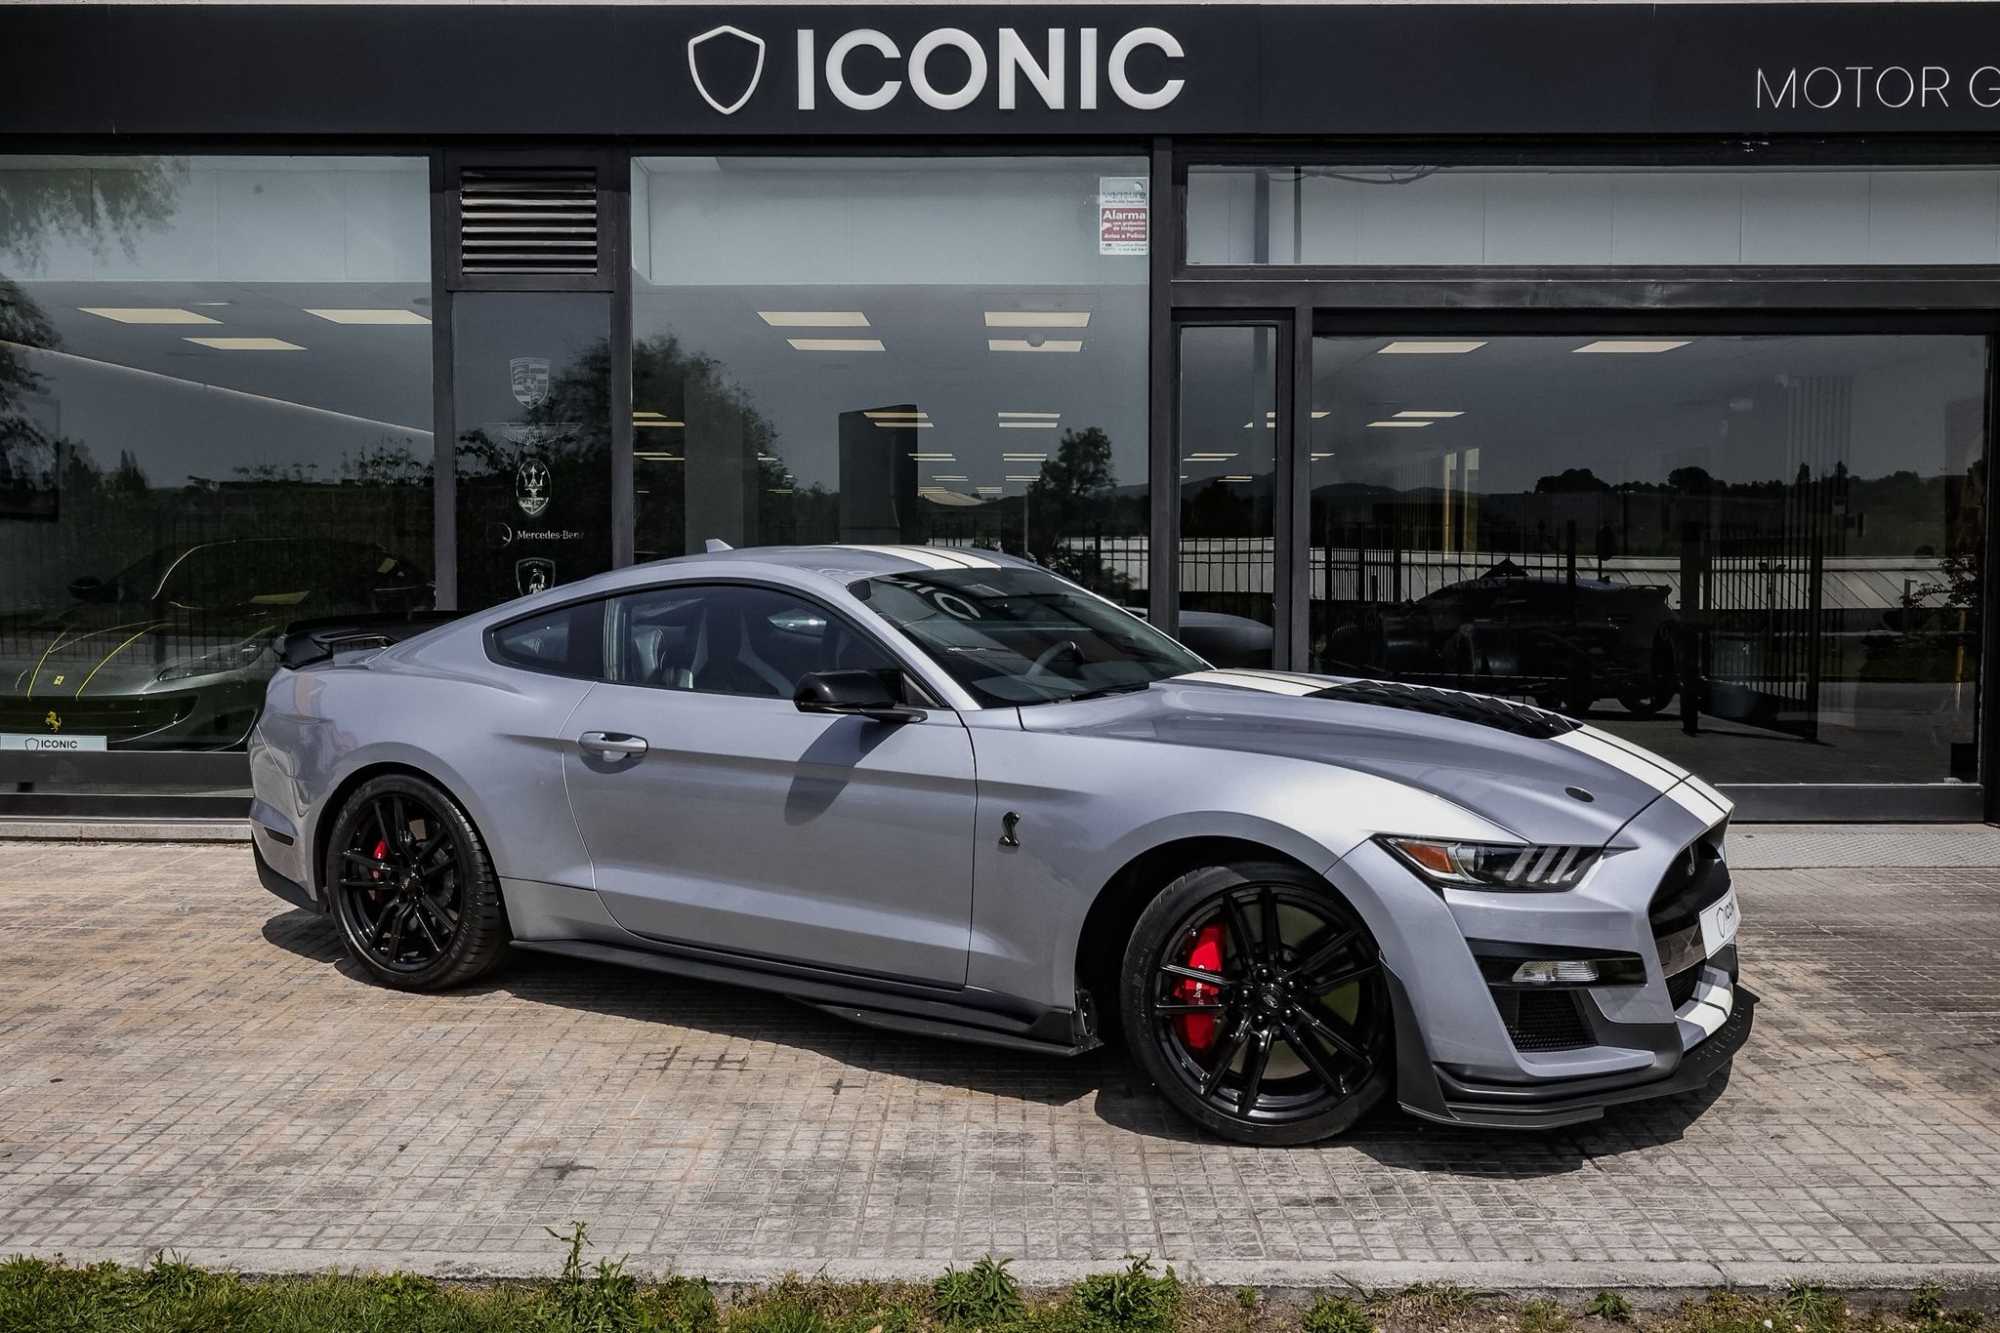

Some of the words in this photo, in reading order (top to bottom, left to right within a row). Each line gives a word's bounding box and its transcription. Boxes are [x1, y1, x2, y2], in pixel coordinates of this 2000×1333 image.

[797, 27, 1186, 111] ICONIC
[1757, 66, 1950, 109] MOTOR
[1103, 210, 1146, 220] Alarma
[517, 530, 585, 540] Mercedes-Benz
[41, 740, 78, 749] ICONIC
